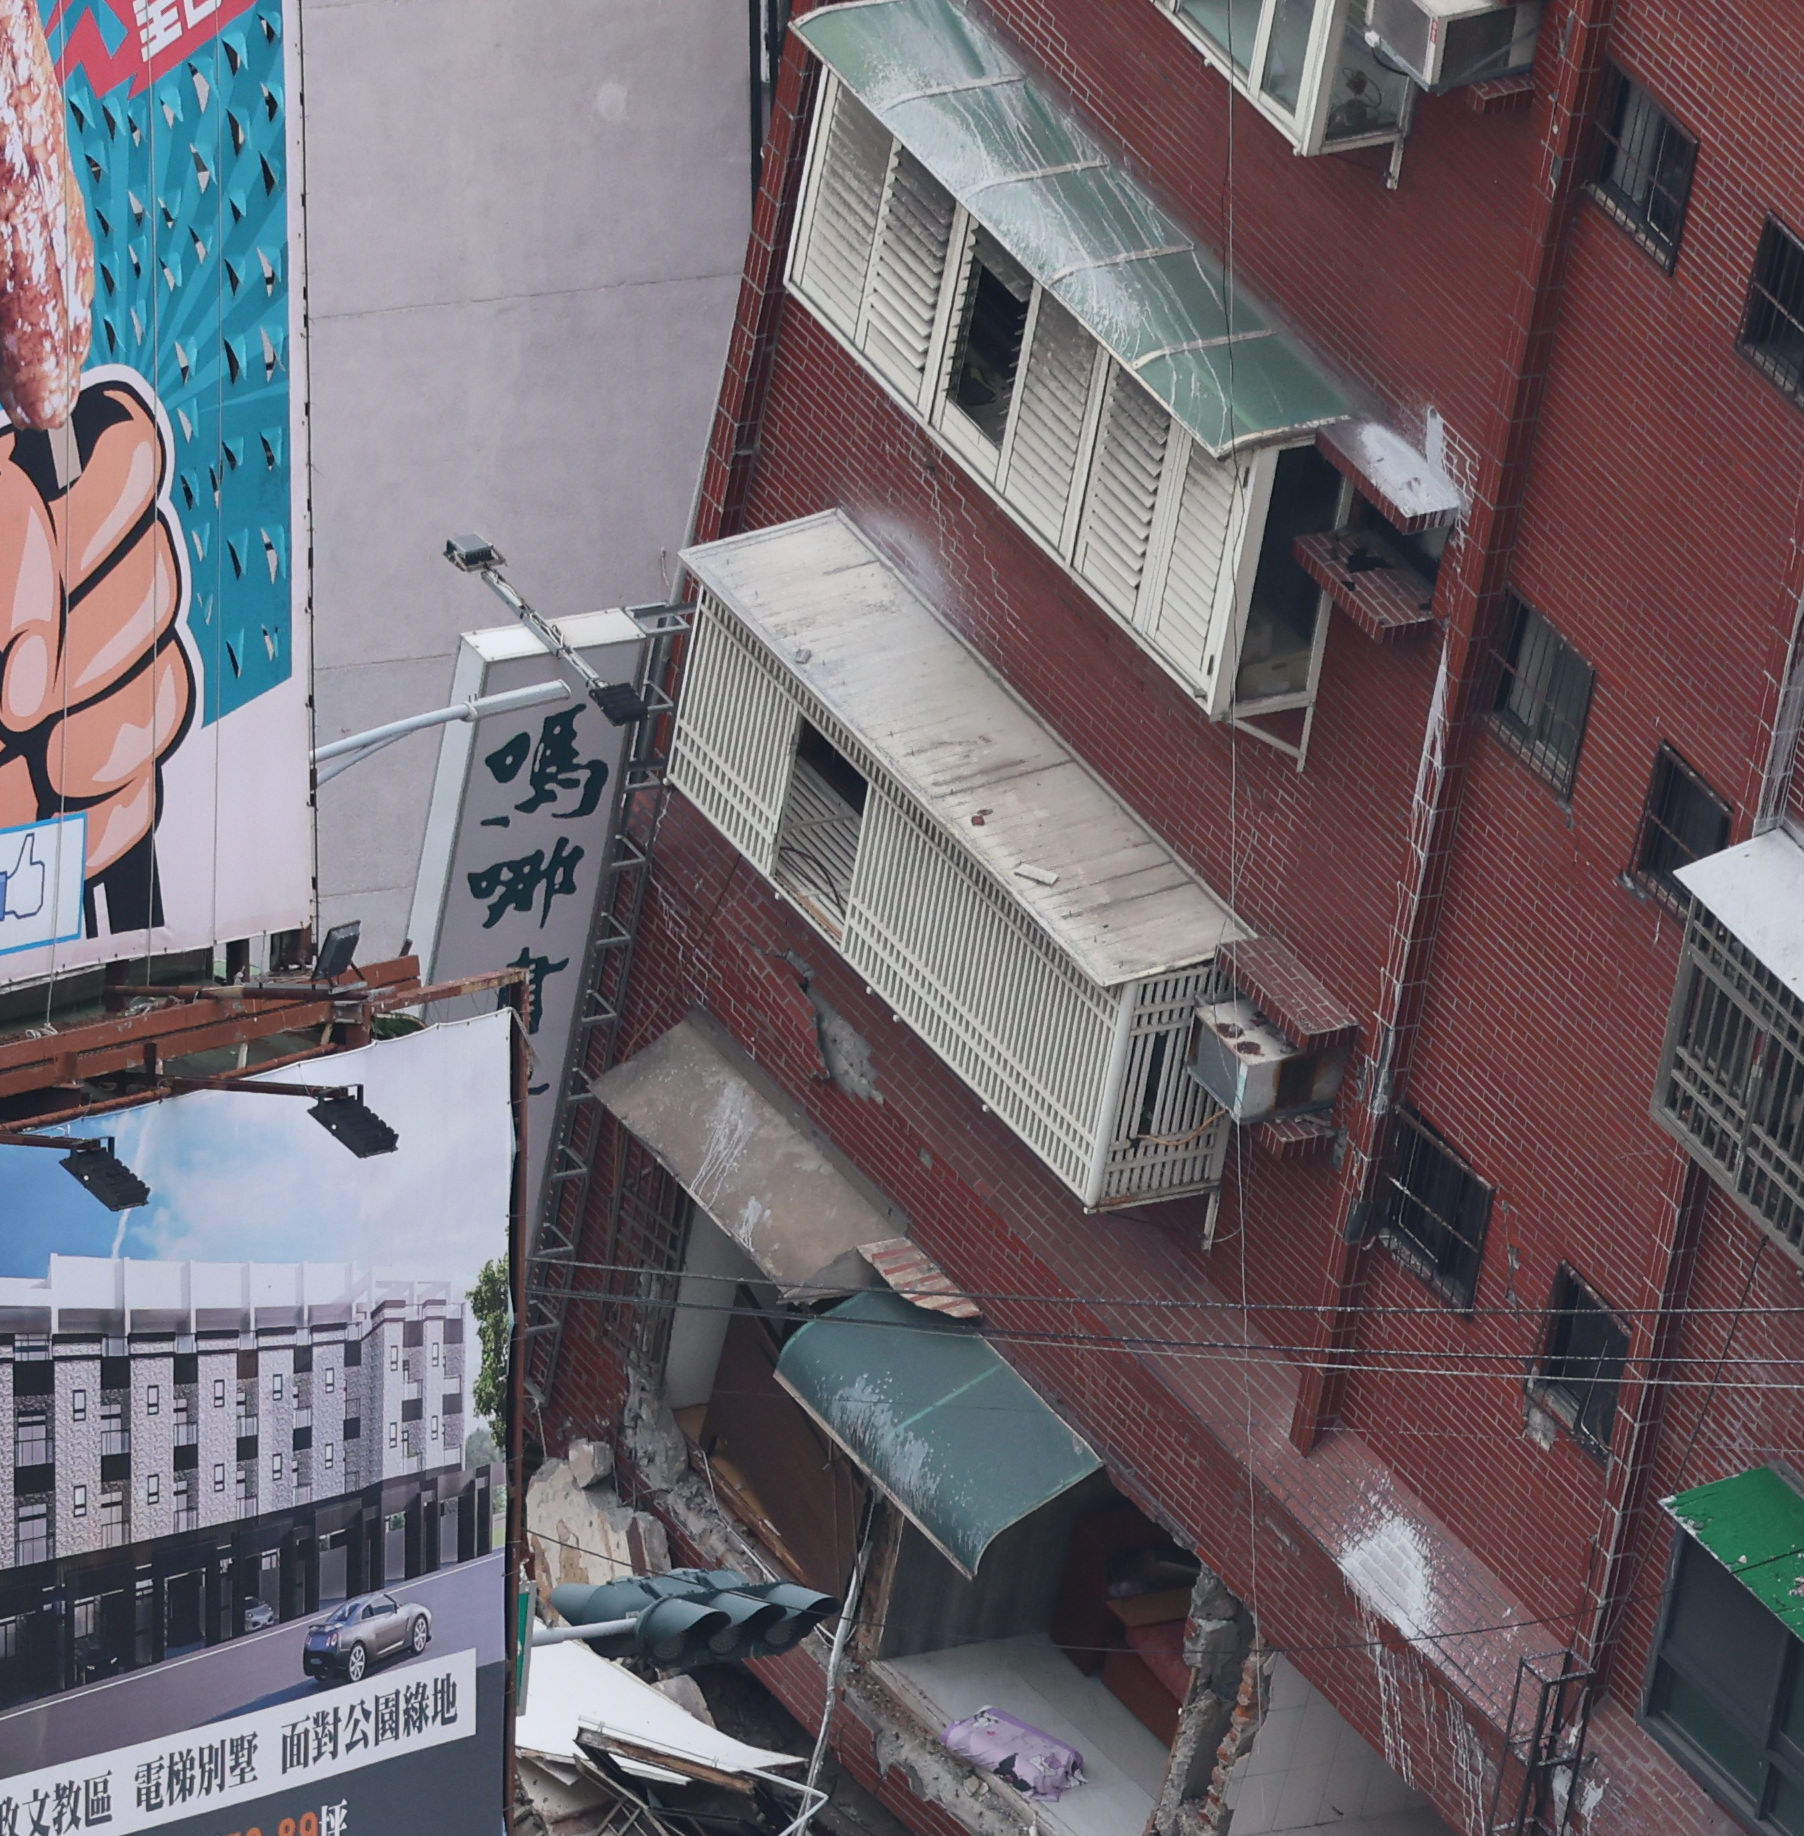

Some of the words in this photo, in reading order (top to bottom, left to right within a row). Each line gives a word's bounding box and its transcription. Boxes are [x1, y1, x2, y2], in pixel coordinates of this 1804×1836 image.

[467, 703, 609, 1094] 嗎哪書
[134, 1731, 260, 1813] 電梯別墅
[280, 1671, 459, 1776] 面對公園綠地
